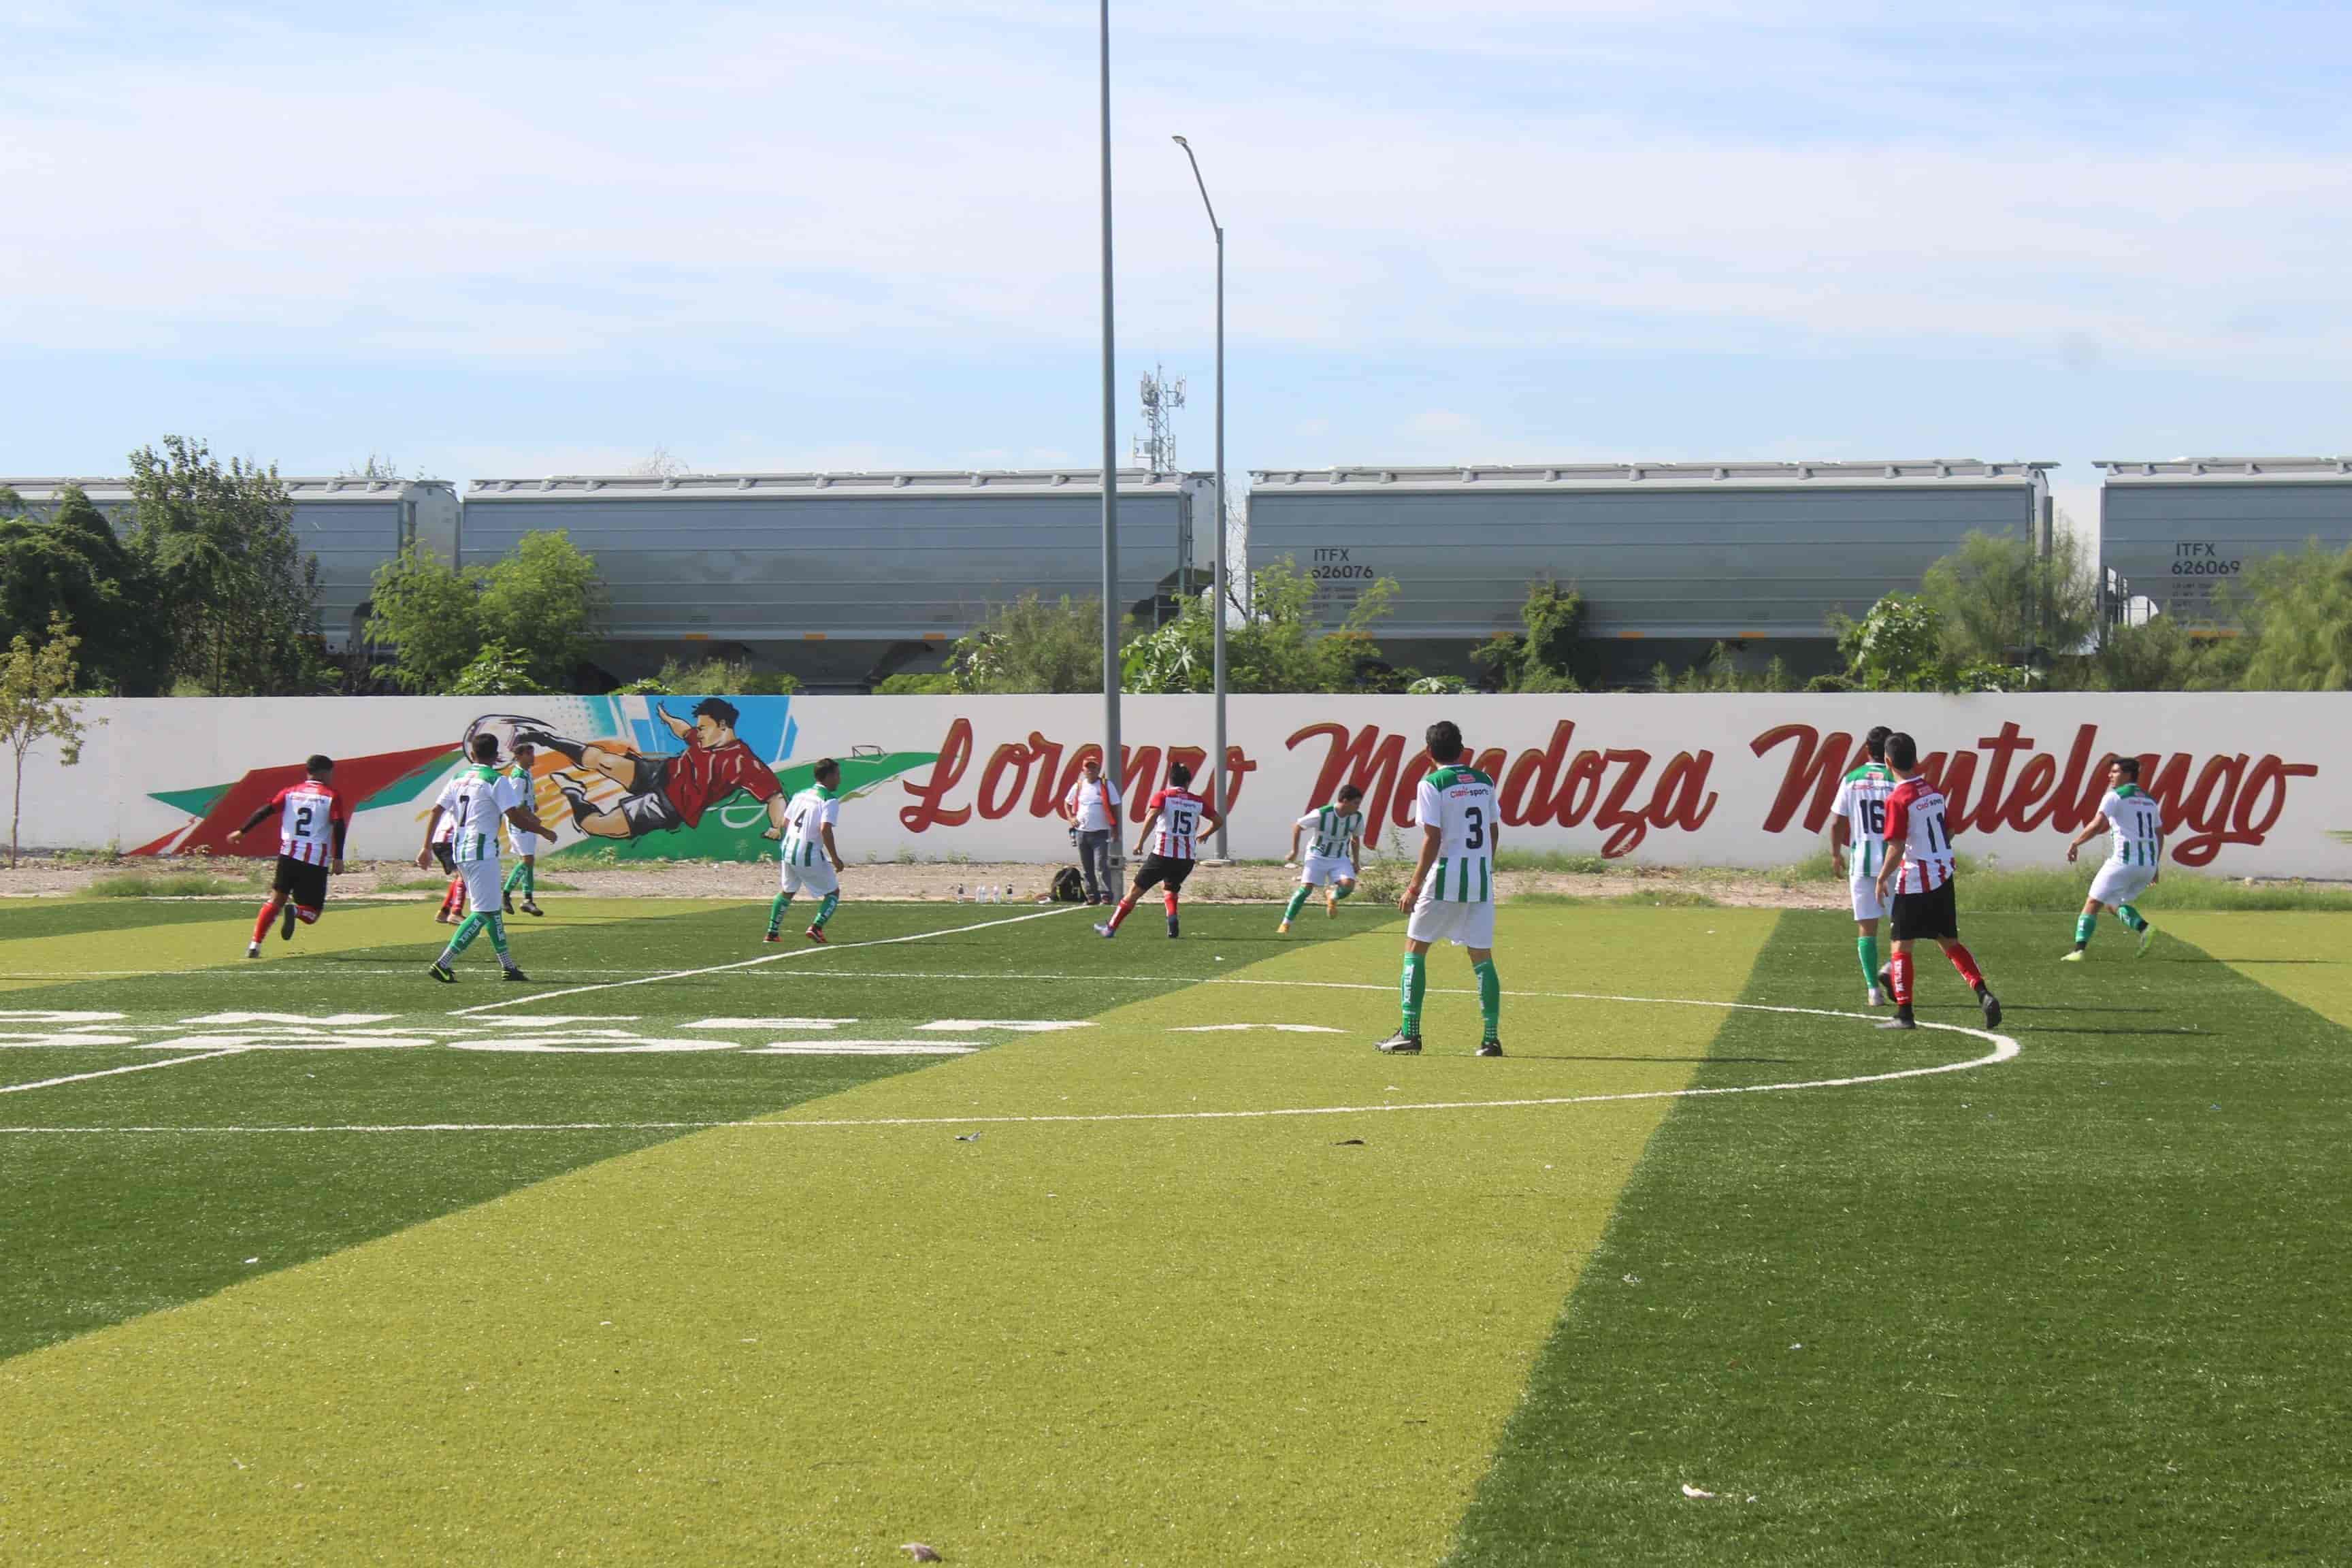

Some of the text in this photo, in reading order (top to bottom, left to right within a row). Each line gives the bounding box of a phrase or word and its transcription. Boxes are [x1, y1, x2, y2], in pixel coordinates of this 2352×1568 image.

[1313, 548, 1350, 561] ITFX
[2176, 542, 2215, 556] ITFX
[1311, 565, 1373, 578] 626076
[2172, 560, 2240, 575] 626069
[295, 807, 312, 836] 2
[459, 795, 470, 828] 7
[794, 808, 806, 833] 4
[1172, 810, 1192, 835] 15
[1859, 799, 1884, 834] 16
[1465, 806, 1484, 849] 3
[1927, 812, 1952, 853] 11
[2137, 811, 2153, 839] 11
